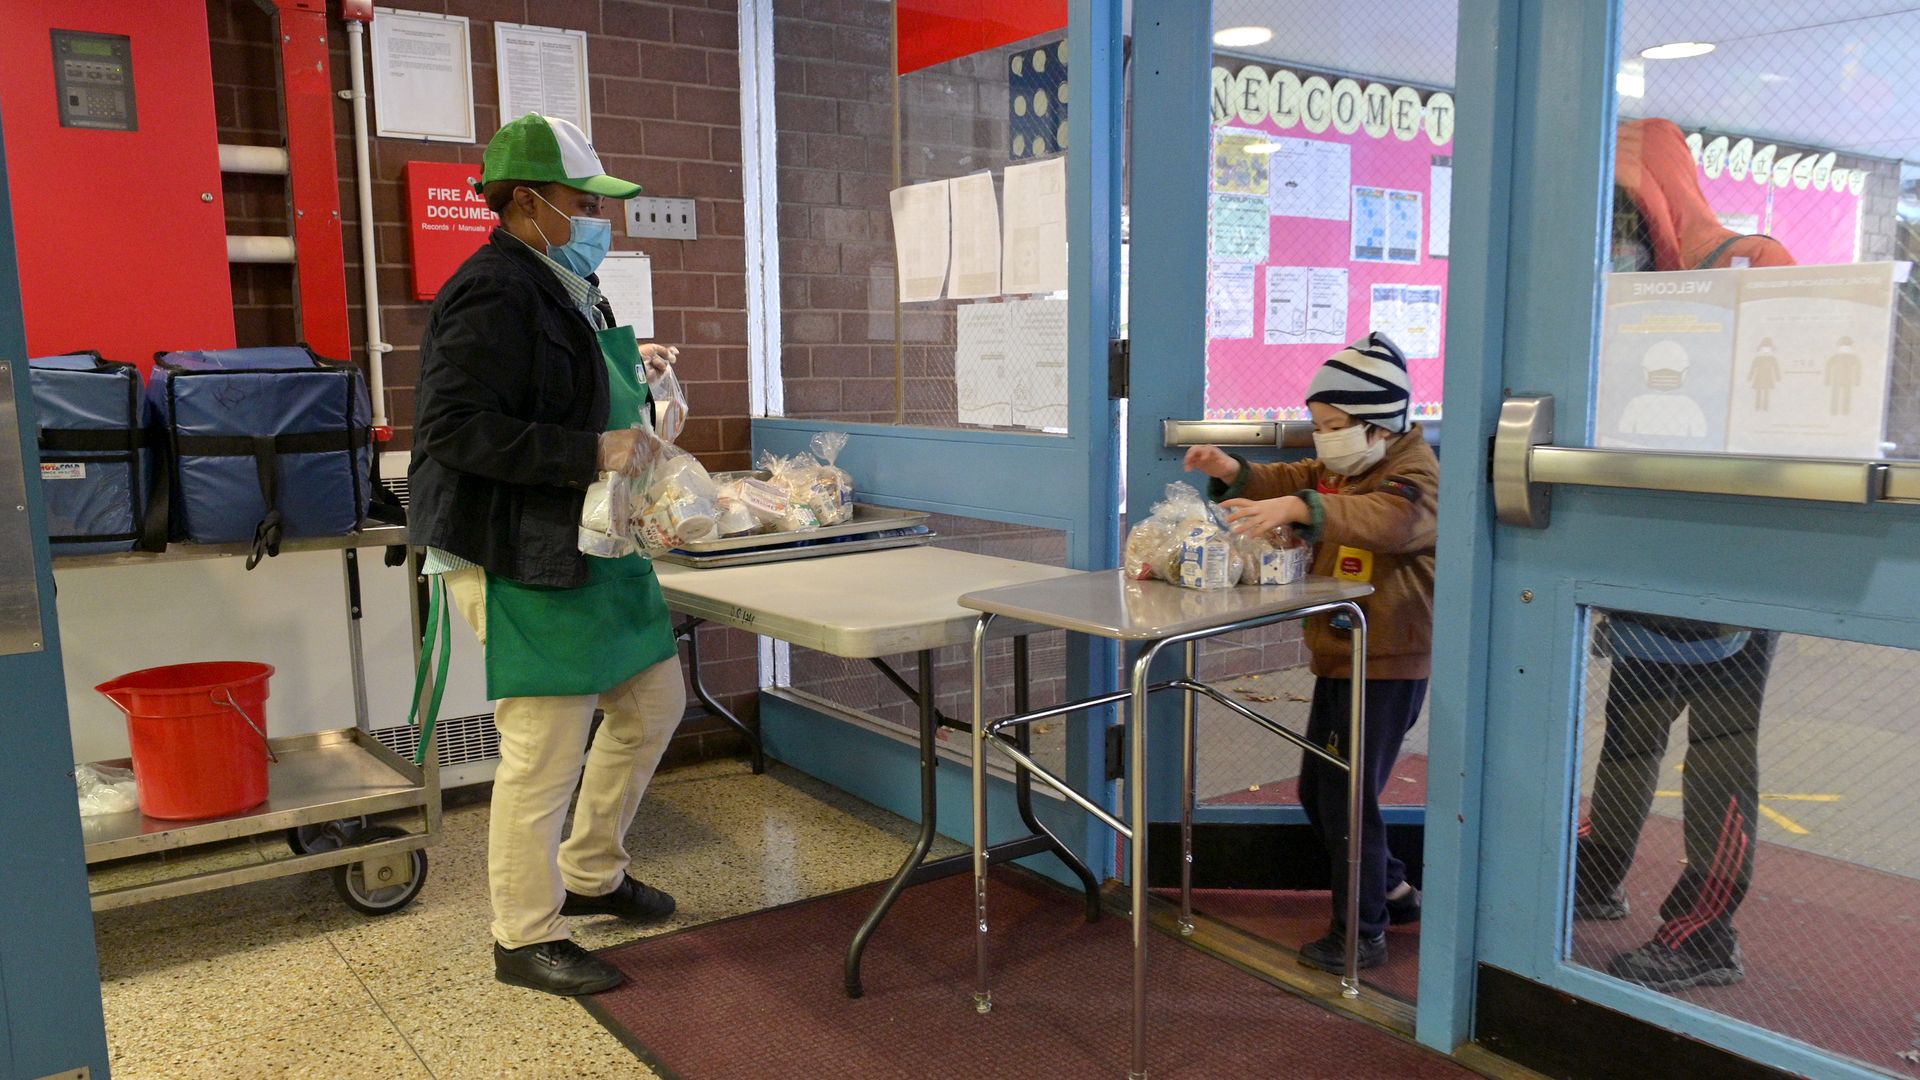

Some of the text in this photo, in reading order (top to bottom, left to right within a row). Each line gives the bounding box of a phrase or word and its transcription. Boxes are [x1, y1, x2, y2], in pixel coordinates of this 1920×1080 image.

[1211, 74, 1413, 131] WELCOME
[428, 188, 461, 200] FIRE
[421, 222, 449, 231] Records
[458, 224, 486, 232] Manuals
